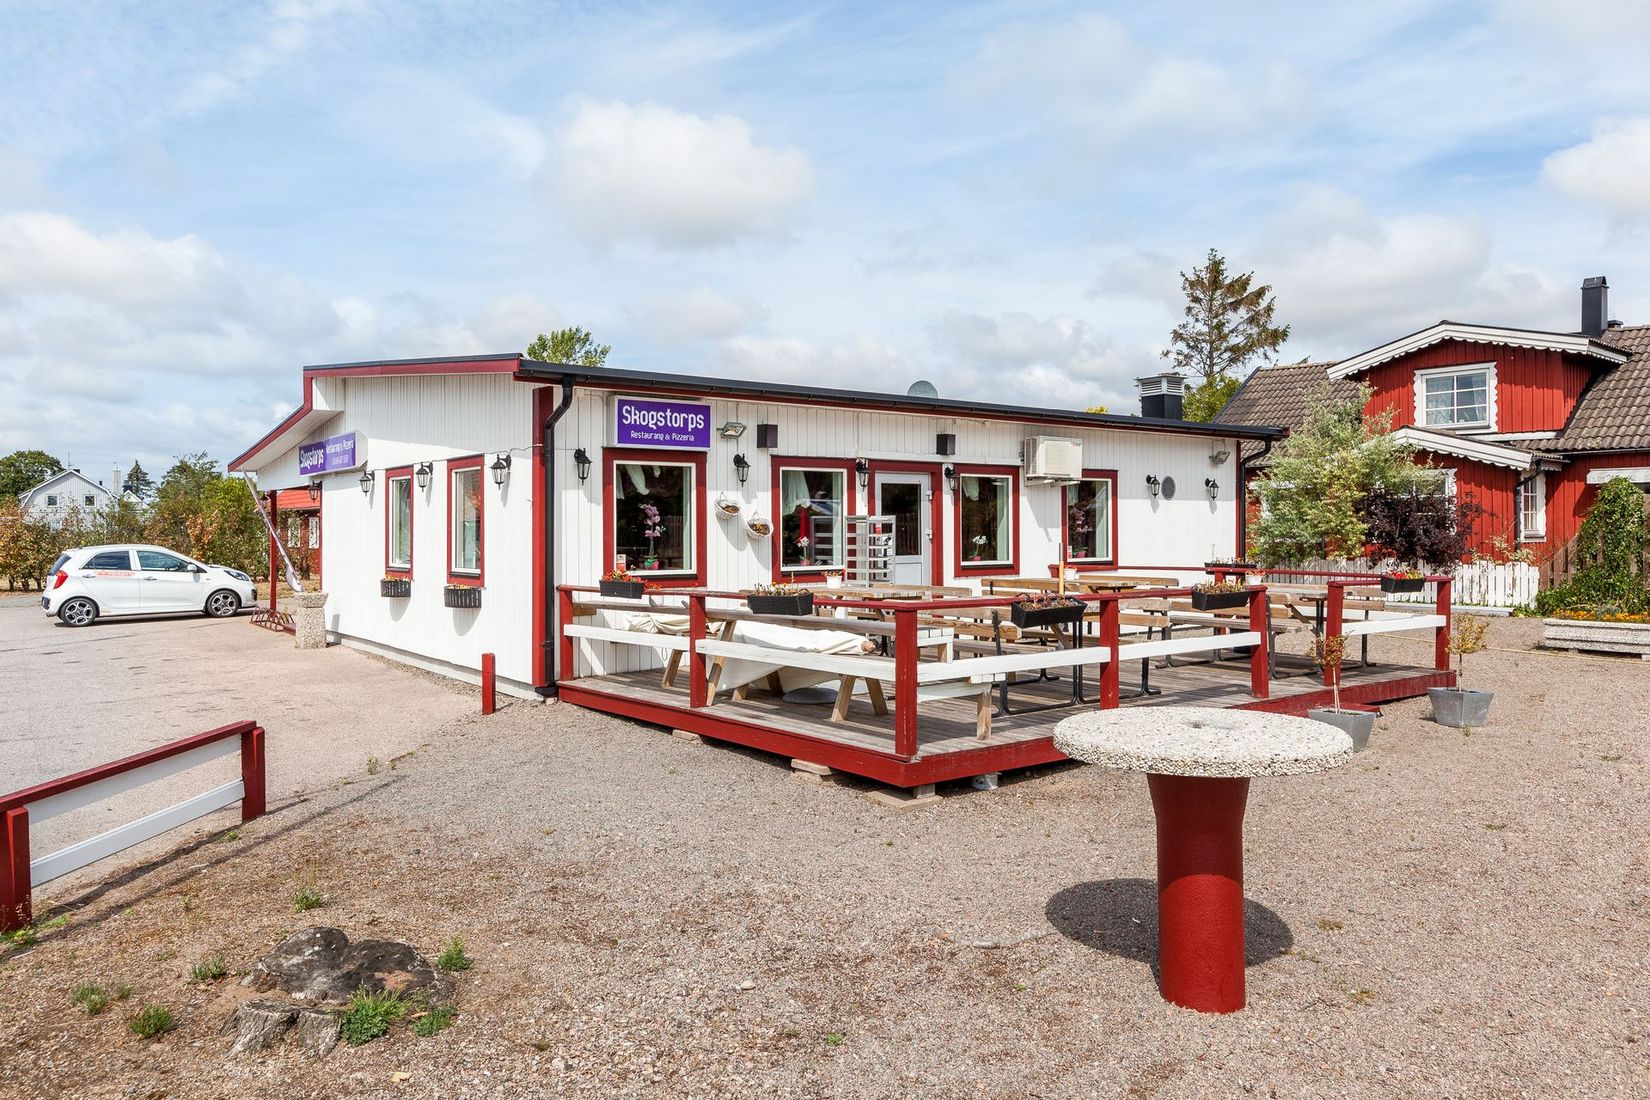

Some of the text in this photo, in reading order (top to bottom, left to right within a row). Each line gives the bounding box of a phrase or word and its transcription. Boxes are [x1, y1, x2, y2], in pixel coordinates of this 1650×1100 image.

[622, 405, 705, 432] Skogstorps
[630, 430, 695, 442] Restaurang & Pizzeria
